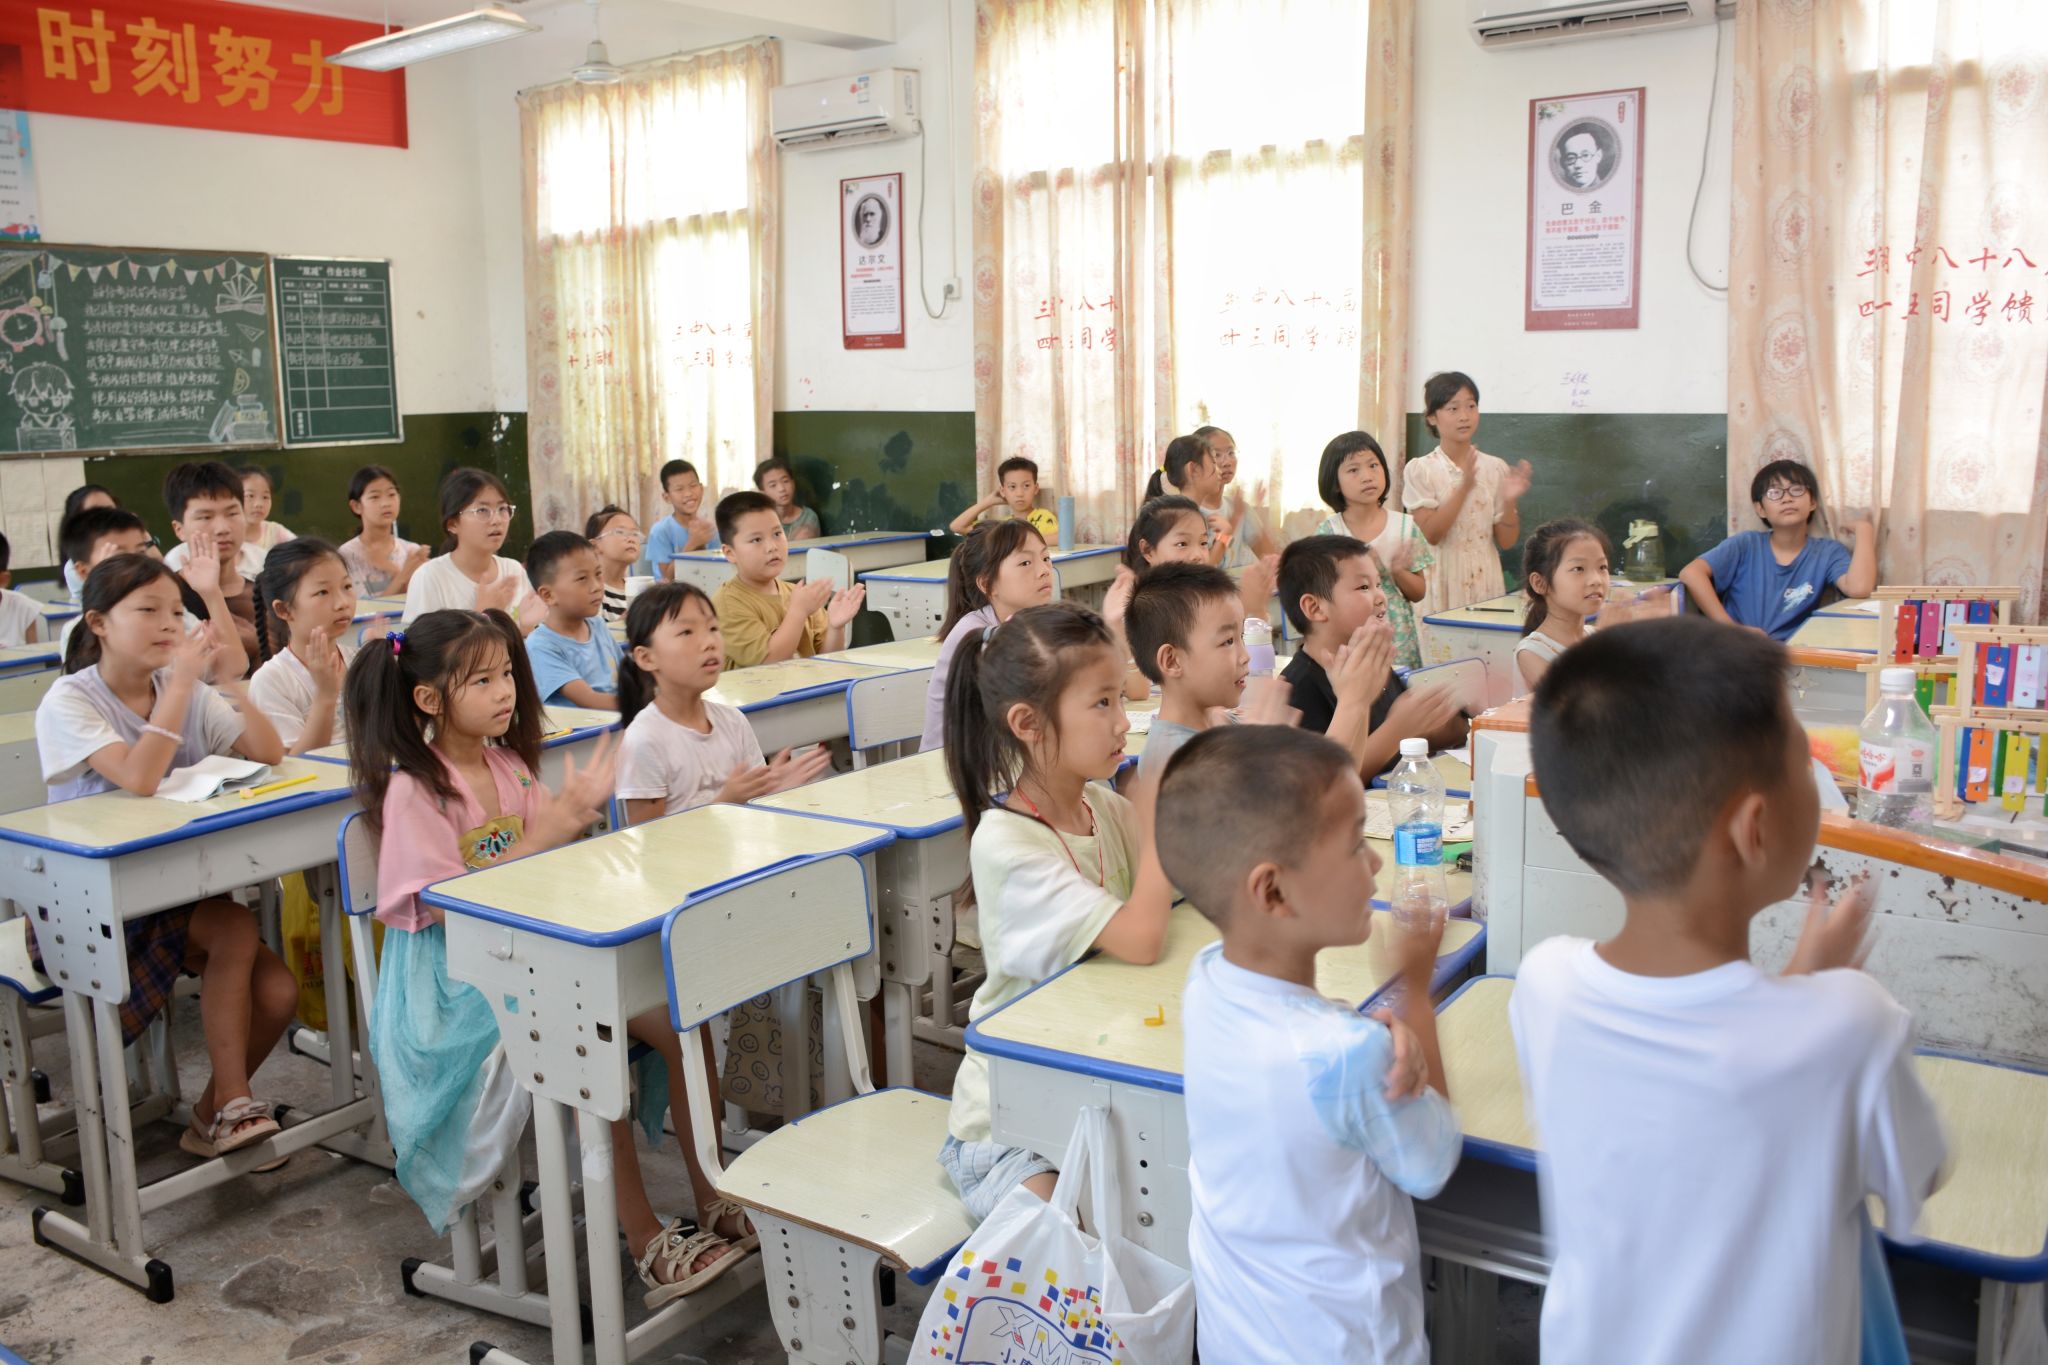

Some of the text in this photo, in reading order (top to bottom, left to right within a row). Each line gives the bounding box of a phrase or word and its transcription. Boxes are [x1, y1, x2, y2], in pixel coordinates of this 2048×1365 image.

[36, 7, 345, 116] 时刻努力
[1561, 200, 1603, 216] 巴金
[858, 253, 886, 266] 达尔文
